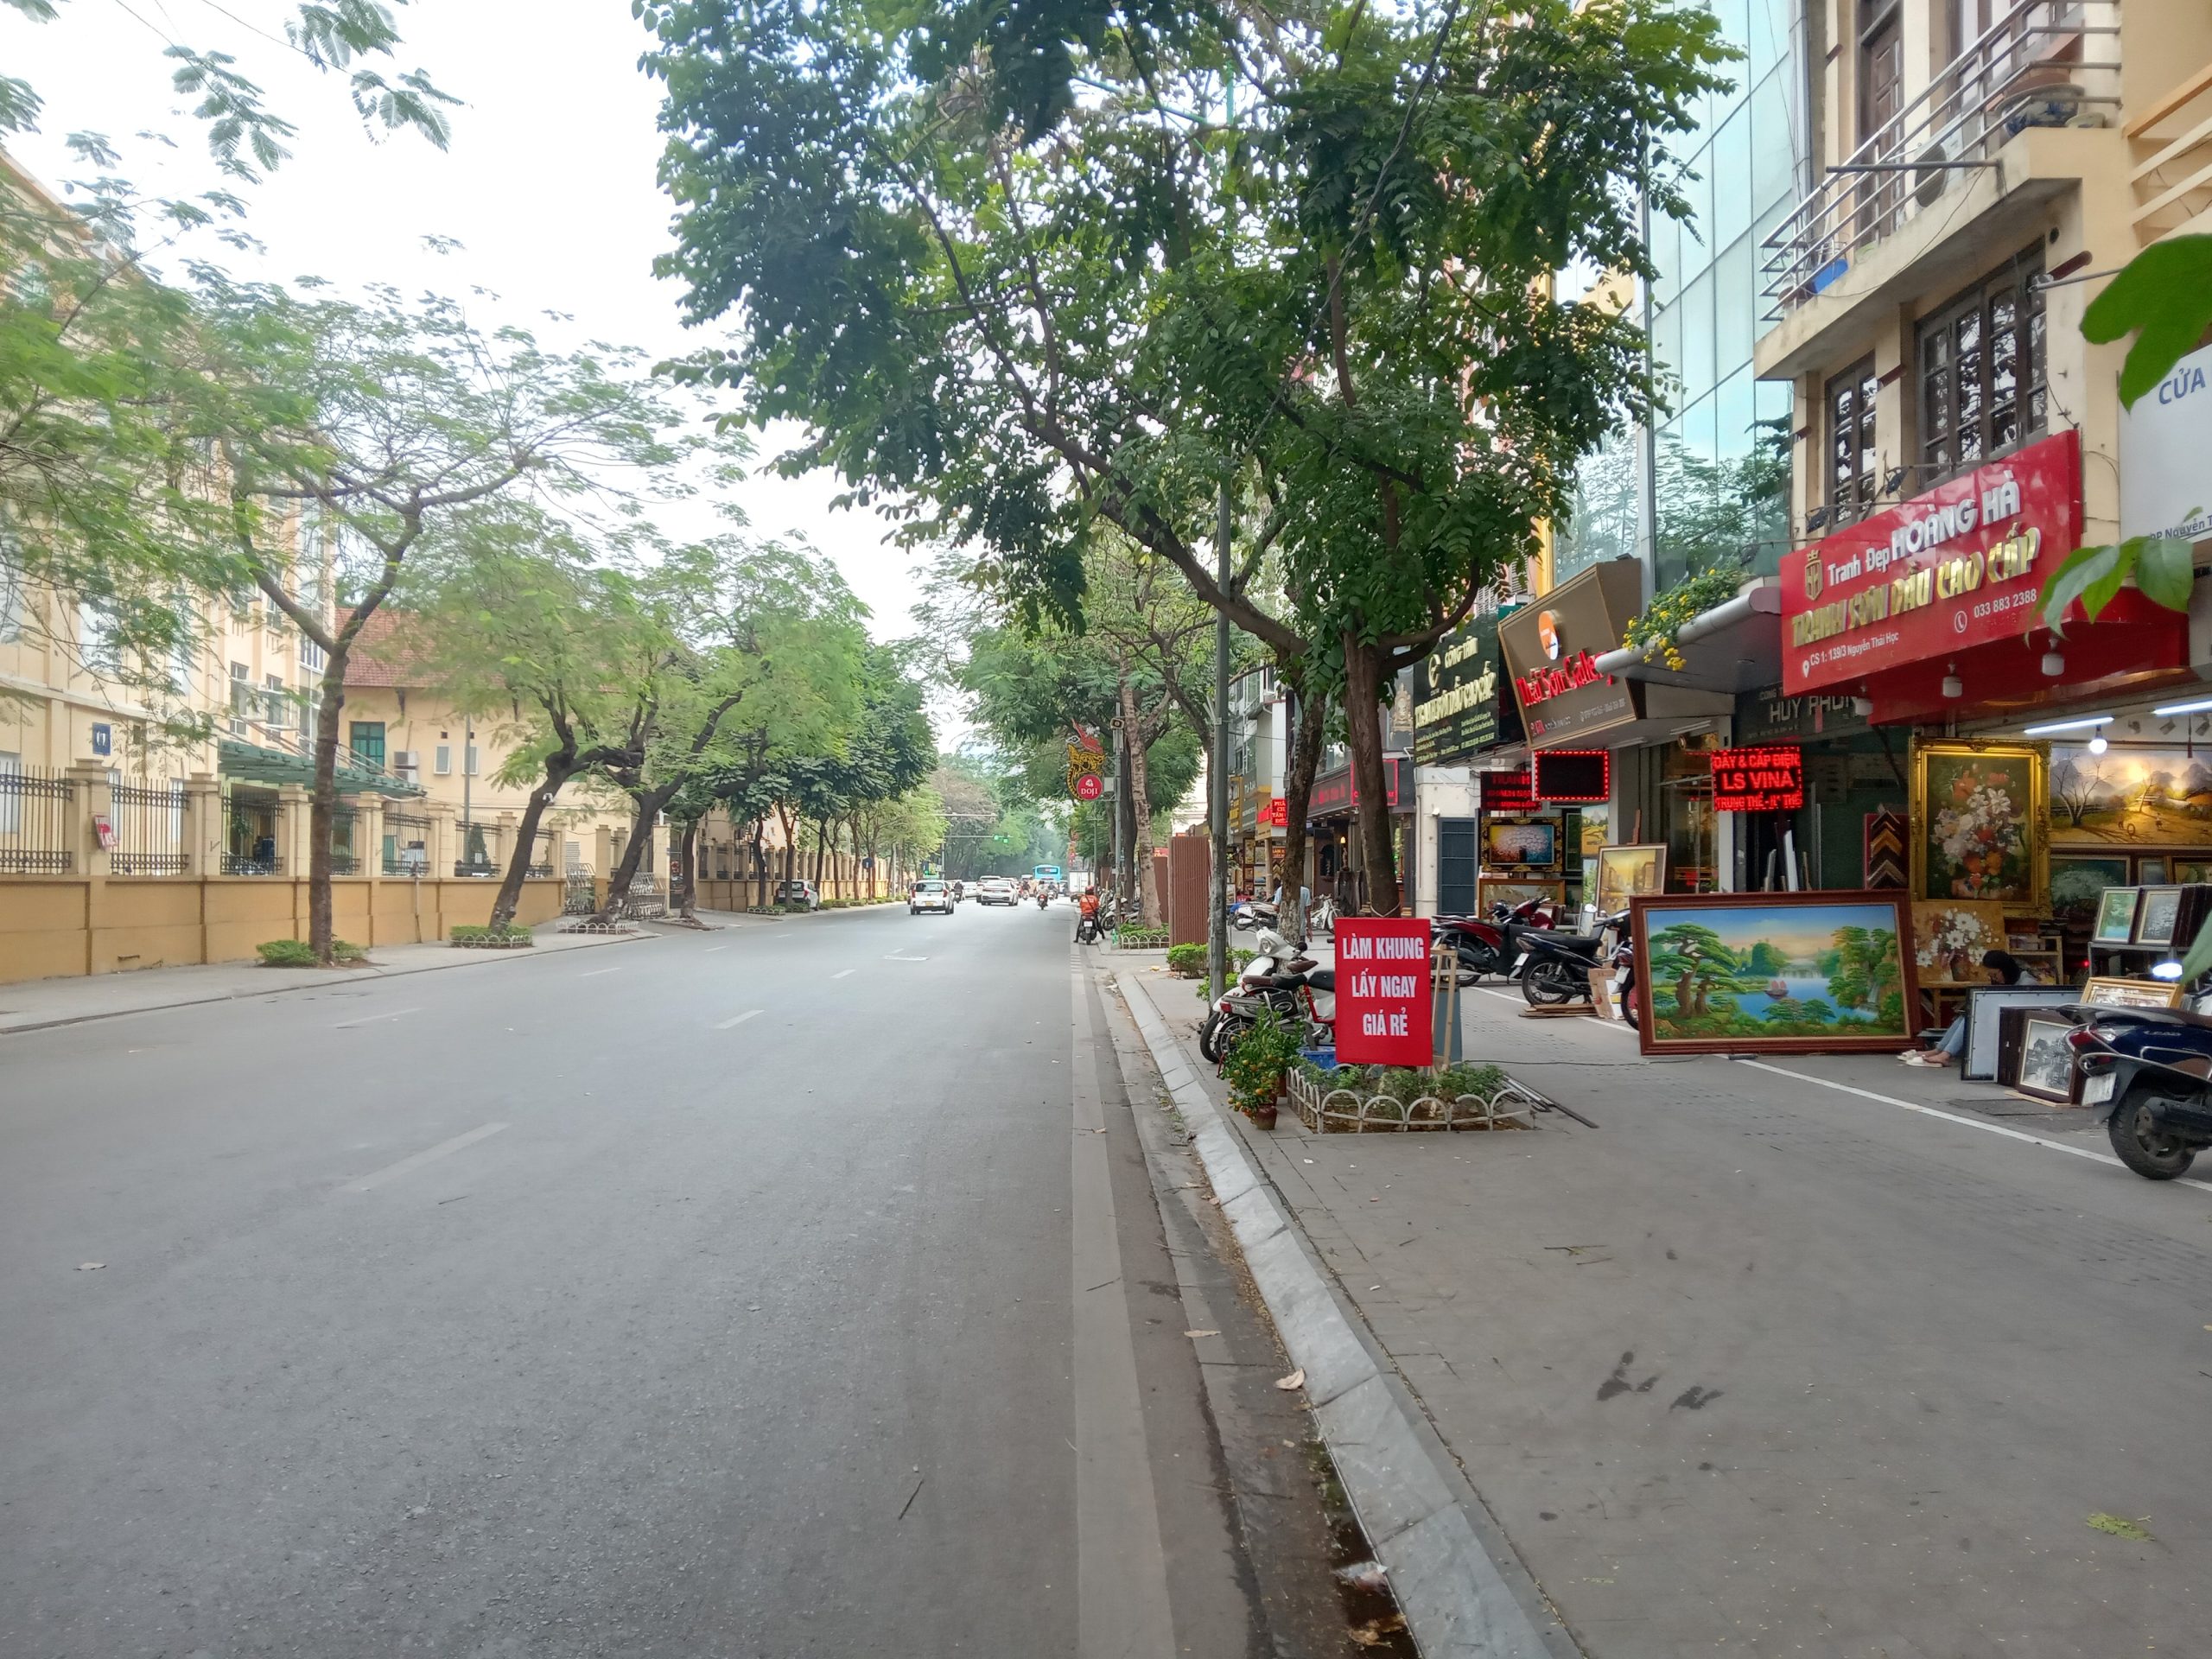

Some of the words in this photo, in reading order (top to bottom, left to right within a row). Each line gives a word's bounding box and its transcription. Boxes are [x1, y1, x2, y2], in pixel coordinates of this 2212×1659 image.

[2158, 366, 2206, 405] CỬA
[1827, 554, 1861, 587] Tranh
[1866, 547, 1890, 574] Đẹp
[1891, 499, 1978, 562] HOÀNG
[1982, 470, 2020, 526] HÀ
[1791, 600, 1847, 647] TRANH
[1848, 582, 1890, 630] SƠN
[1891, 561, 1934, 616] DẦU
[1937, 551, 1985, 599] CAO
[1988, 522, 2041, 583] CẤP
[1974, 603, 1991, 619] 033
[1993, 599, 2011, 614] 883
[2012, 588, 2037, 608] 2388
[1563, 650, 1614, 687] Galle
[1770, 696, 1802, 723] HUY
[1081, 787, 1098, 797] DOJI
[1722, 772, 1745, 790] LS
[1749, 771, 1795, 788] VINA
[1343, 932, 1372, 960] LÀM
[1376, 937, 1425, 960] KHUNG
[1351, 968, 1377, 998] LẤY
[1381, 976, 1417, 998] NGAY
[1363, 1009, 1387, 1036] GIÁ
[1390, 1007, 1408, 1037] RẺ
